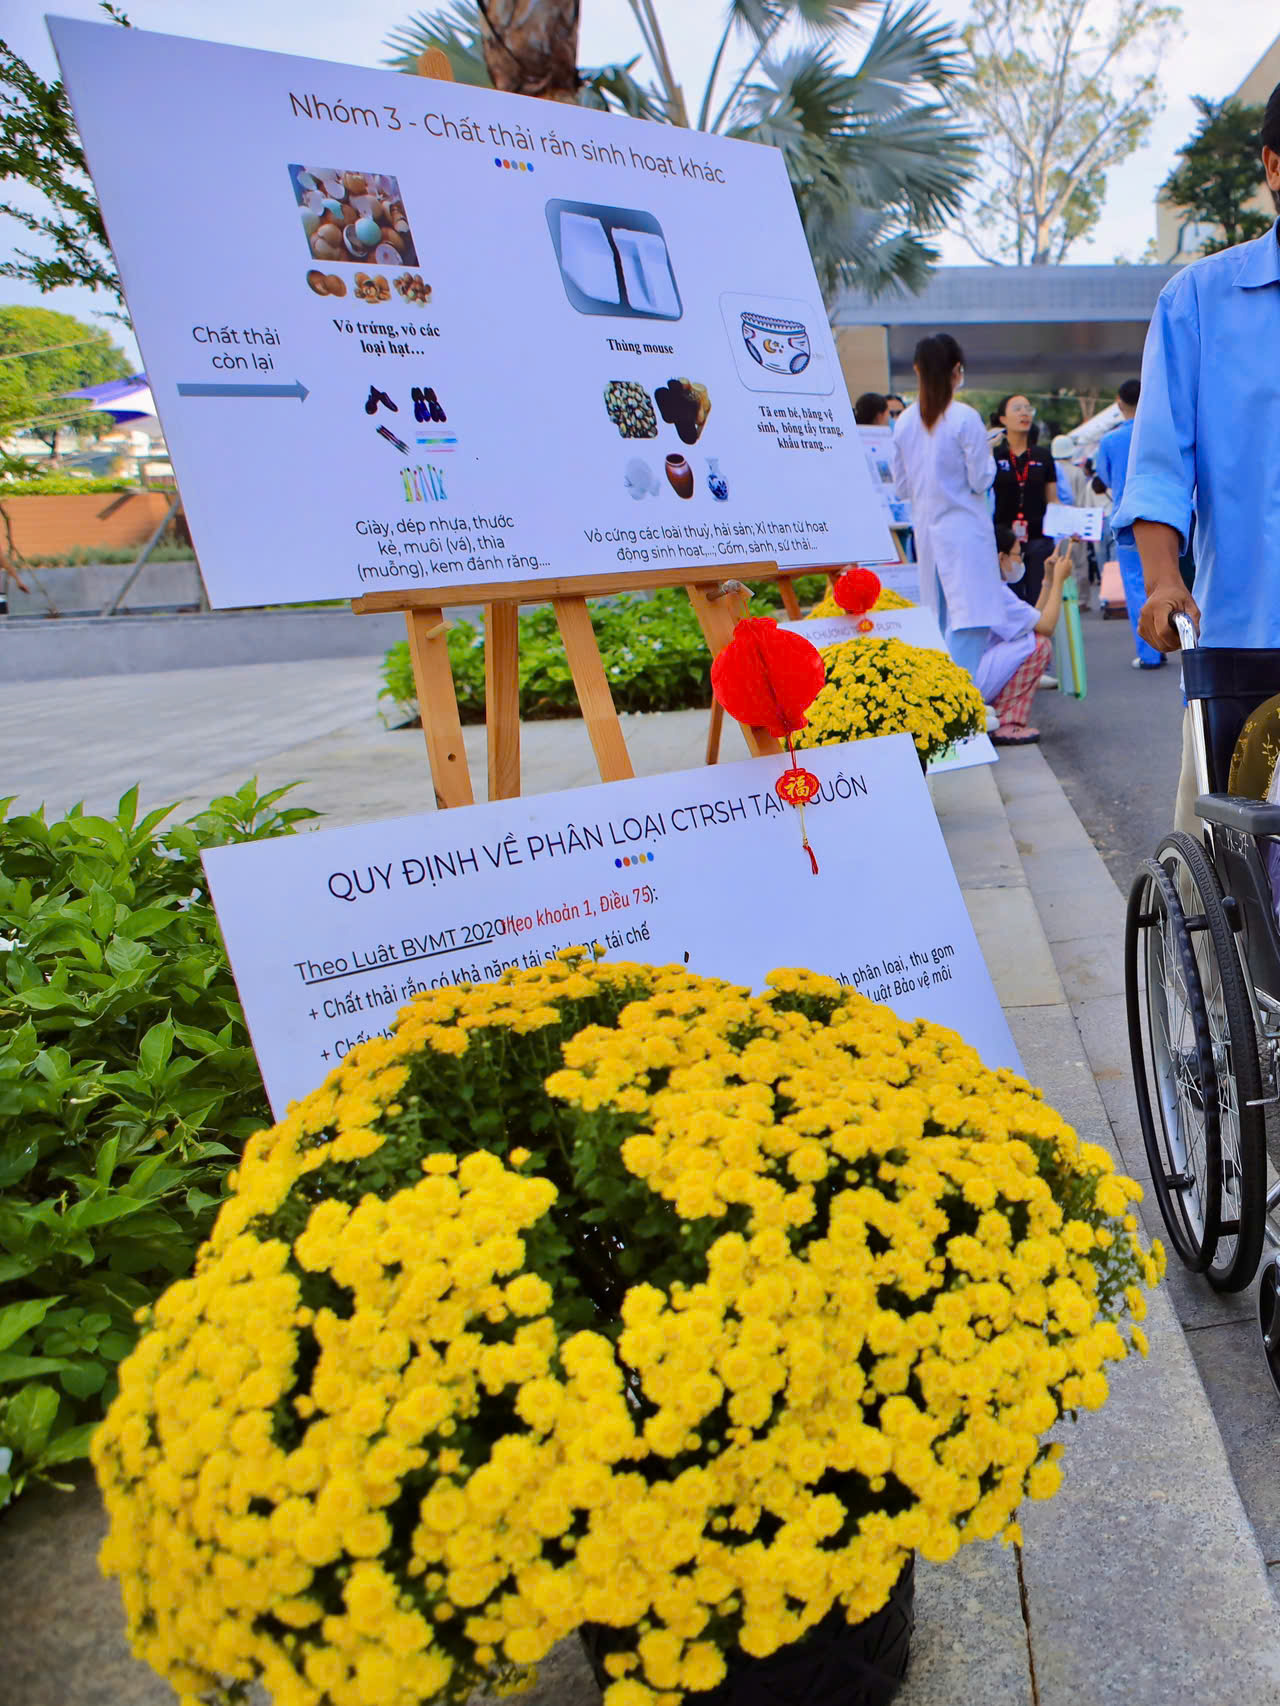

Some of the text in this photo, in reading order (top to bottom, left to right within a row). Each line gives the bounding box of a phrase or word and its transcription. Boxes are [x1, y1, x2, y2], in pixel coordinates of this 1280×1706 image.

[289, 91, 380, 128] Nhóm
[383, 105, 401, 131] 3
[423, 112, 485, 143] Chất
[488, 123, 535, 151] thải
[540, 129, 577, 158] rắn
[583, 139, 626, 167] sinh
[629, 147, 677, 178] hoạt
[679, 155, 726, 184] khác
[192, 325, 281, 346] Chất thải
[333, 318, 441, 339] Vỏ trứng, vỏ các
[361, 339, 385, 357] loại
[606, 338, 674, 355] Thùng mouse
[212, 351, 275, 374] còn lại
[773, 409, 787, 418] em
[801, 407, 823, 422] băng
[823, 408, 833, 422] vệ
[757, 421, 779, 434] sinh,
[781, 422, 804, 436] bông
[818, 425, 844, 438] trang,
[777, 434, 800, 449] khẩu
[355, 513, 515, 538] Giày, dép nhựa, thước
[584, 527, 603, 544] Vỏ
[605, 526, 637, 544] cứng
[639, 525, 660, 540] các
[661, 524, 683, 540] loài
[715, 522, 732, 537] hải
[767, 521, 792, 534] than
[793, 520, 805, 533] từ
[806, 520, 829, 535] hoạt
[377, 534, 505, 557] kẻ, muôi (vá), thìa
[617, 547, 649, 563] động
[652, 545, 677, 560] sinh
[717, 540, 748, 555] Gốm,
[748, 540, 777, 554] sành,
[778, 539, 790, 552] sứ
[357, 560, 429, 582] (muỗng),
[430, 558, 464, 574] kem
[466, 555, 504, 571] đánh
[328, 862, 393, 902] QUY
[402, 847, 479, 887] ĐỊNH
[482, 832, 524, 868] VỀ
[527, 823, 604, 861] PHÂN
[609, 811, 668, 845] LOẠI
[671, 797, 747, 833] CTRSH
[294, 957, 348, 981] Theo
[401, 928, 456, 957] BVMT
[536, 903, 581, 927] khoản
[584, 899, 597, 918] 1,
[600, 889, 630, 913] Điều
[633, 884, 658, 904] 75):
[605, 929, 624, 950] tái
[626, 920, 650, 945] chế
[852, 964, 882, 988] phân
[882, 955, 908, 975] loại,
[909, 951, 929, 967] thu
[930, 944, 955, 964] gom
[323, 990, 364, 1019] Chất
[366, 984, 398, 1008] thải
[401, 976, 427, 999] rắn
[431, 971, 450, 990] có
[452, 963, 482, 984] khả
[522, 949, 542, 969] tái
[894, 977, 916, 996] Bảo
[917, 970, 931, 989] vệ
[932, 964, 953, 985] môi
